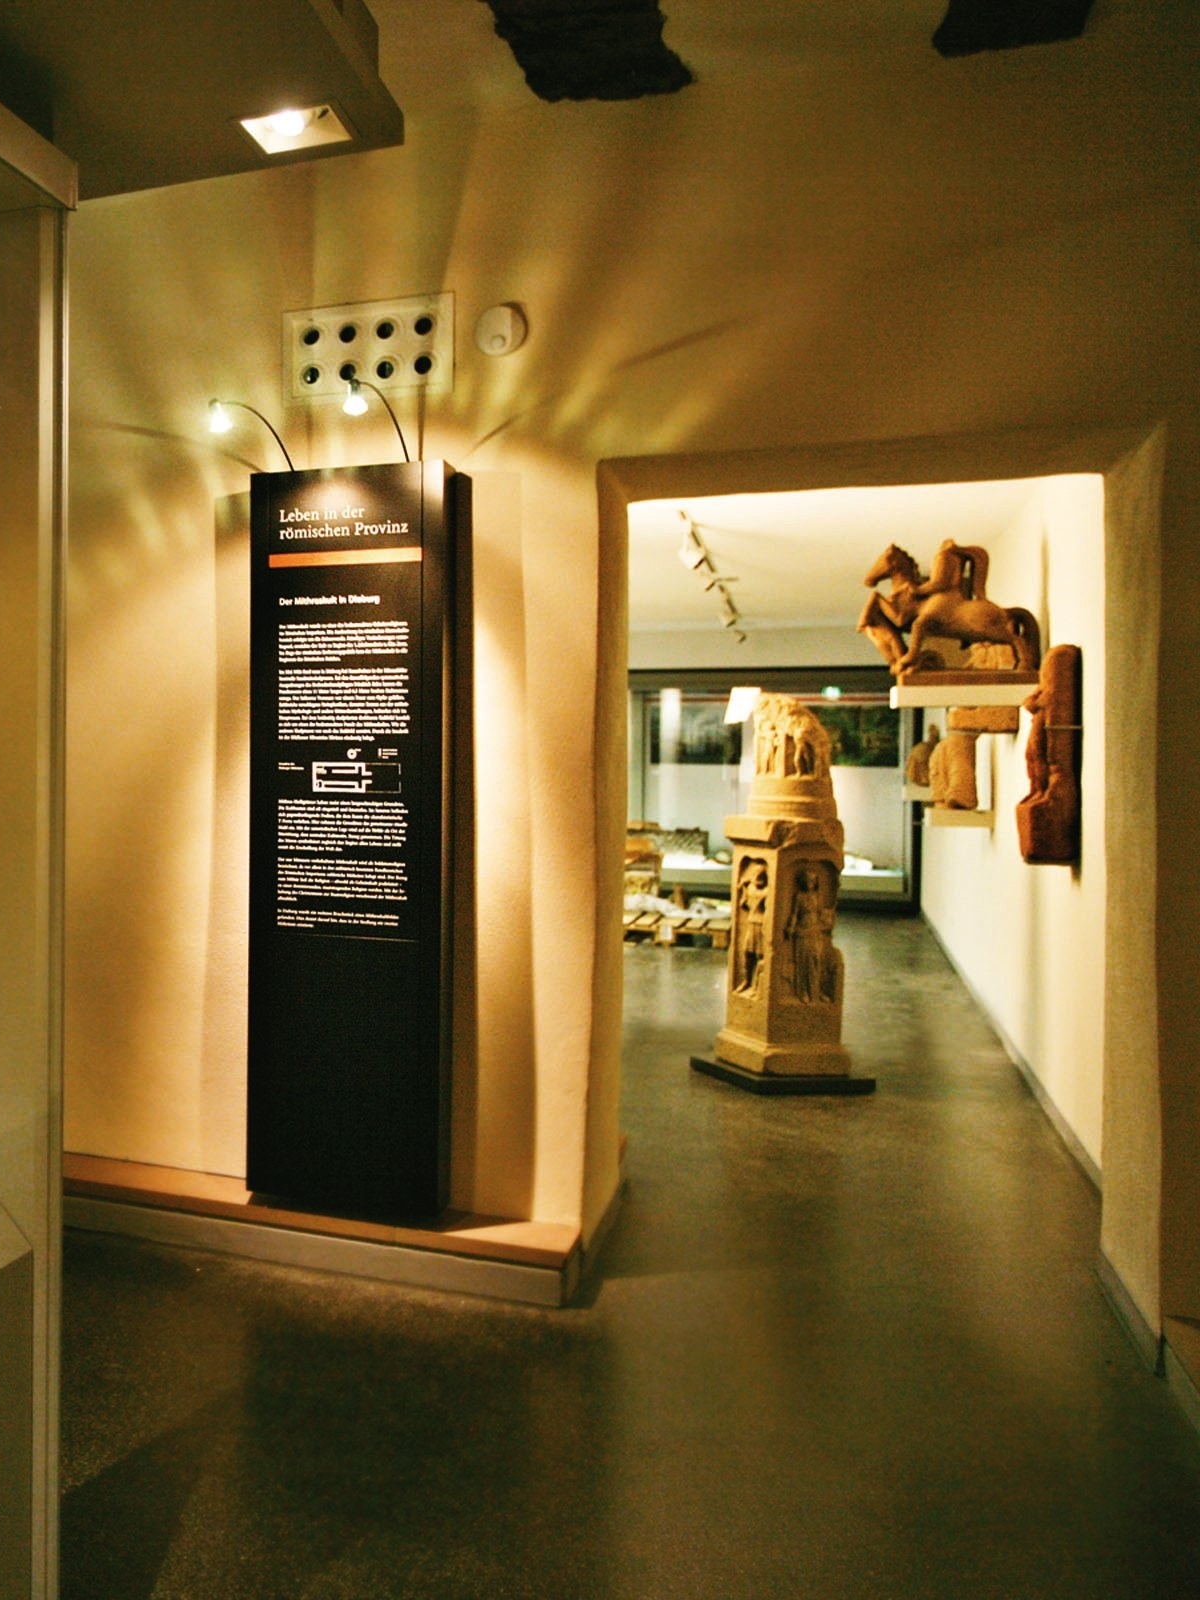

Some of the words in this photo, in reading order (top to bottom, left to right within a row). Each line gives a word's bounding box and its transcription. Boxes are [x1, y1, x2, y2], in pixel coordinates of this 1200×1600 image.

[279, 508, 319, 522] Leben
[324, 507, 337, 521] in
[341, 505, 365, 519] der
[279, 524, 350, 540] römischen
[354, 520, 409, 535] Provinz
[279, 597, 293, 606] Der
